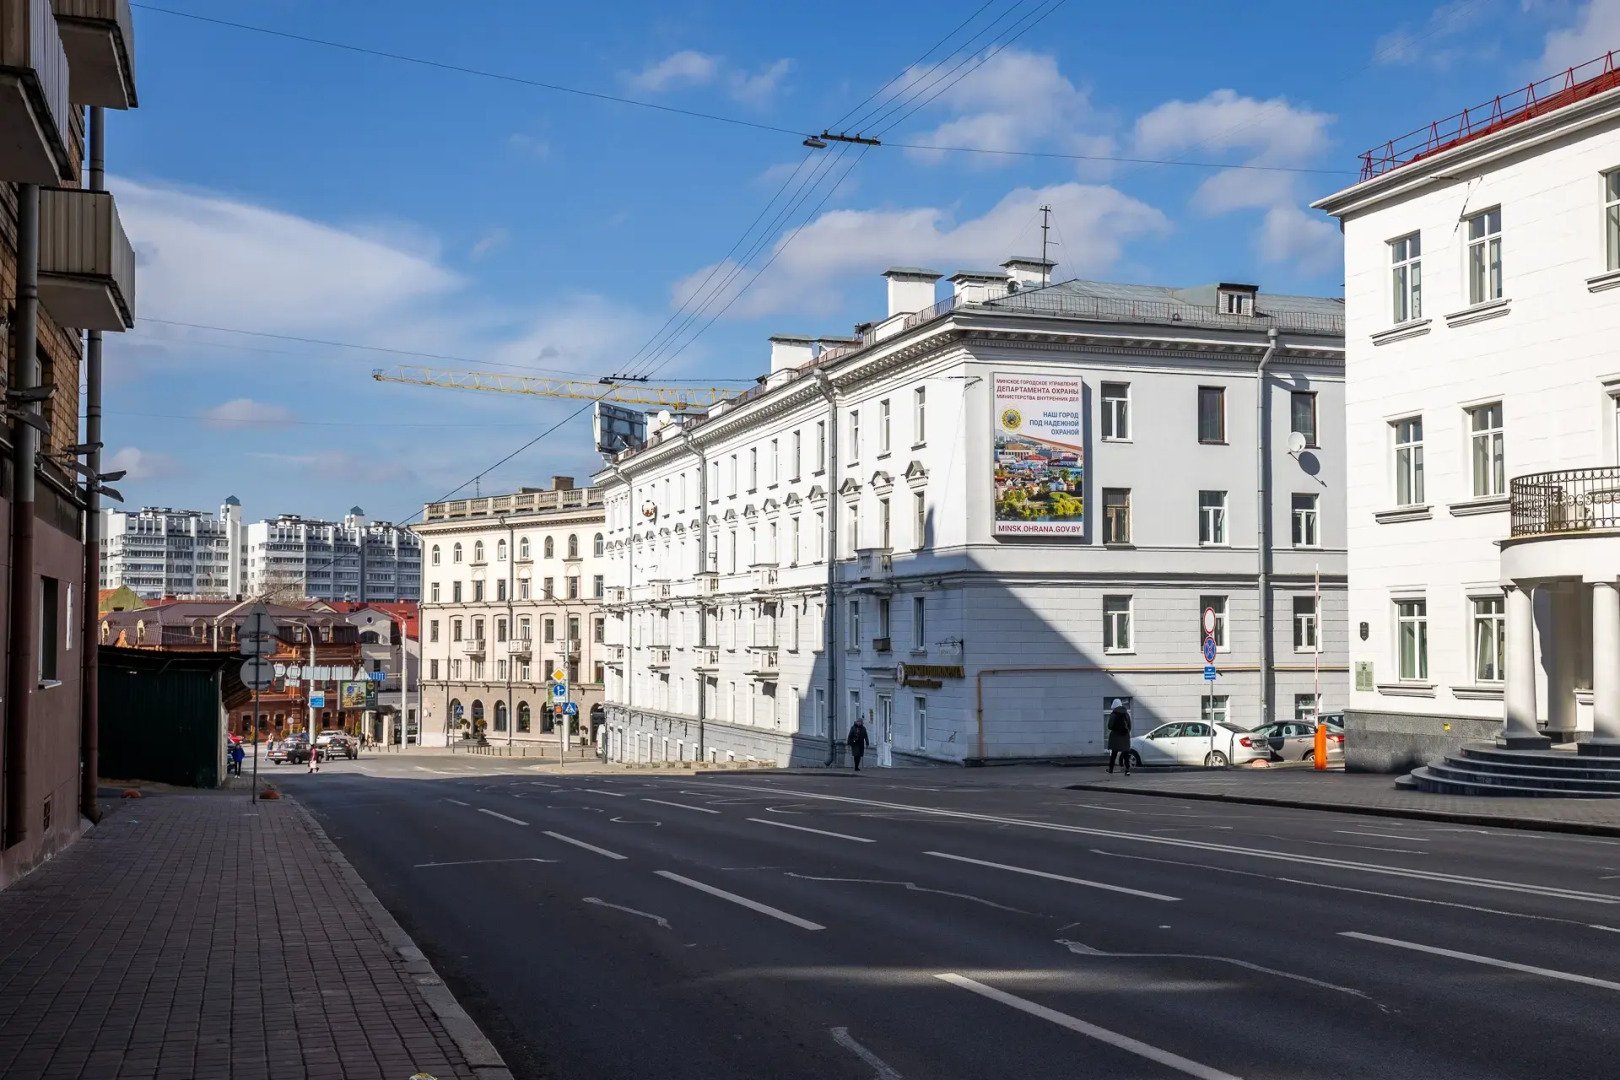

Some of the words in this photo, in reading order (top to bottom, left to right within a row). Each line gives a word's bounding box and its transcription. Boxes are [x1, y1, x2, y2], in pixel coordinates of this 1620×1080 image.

[996, 385, 1050, 394] ДЕПАРТАМЕНТА
[1029, 419, 1043, 427] ПОД
[1043, 419, 1079, 427] НАДЕЖНОЙ
[998, 525, 1081, 533] MINSK.OHRANA.GOV.BY
